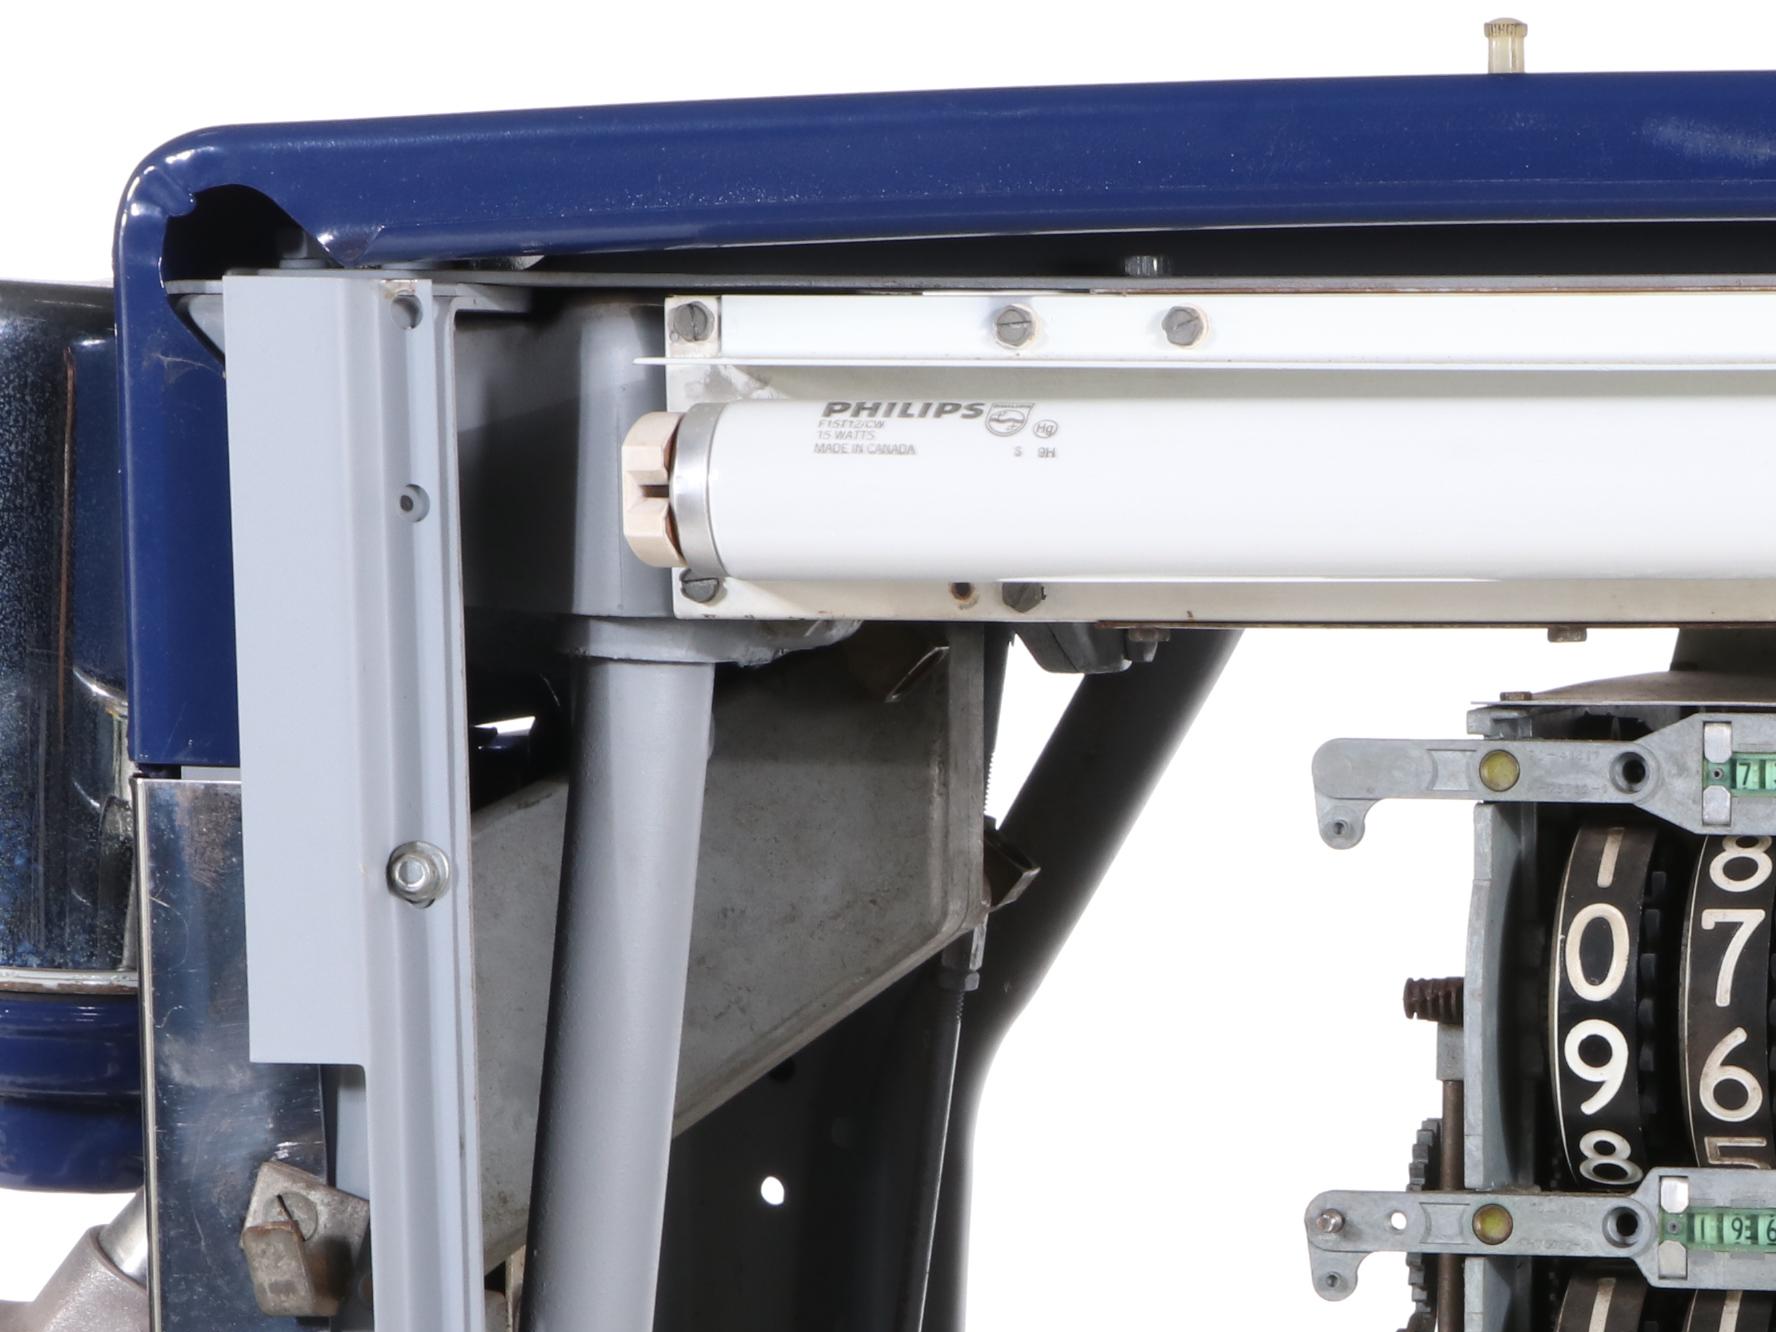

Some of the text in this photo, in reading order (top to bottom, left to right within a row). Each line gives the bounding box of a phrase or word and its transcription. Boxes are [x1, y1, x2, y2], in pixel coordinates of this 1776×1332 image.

[822, 402, 985, 419] PHILIPS
[835, 431, 874, 440] WATTS
[814, 444, 915, 455] MADE IN CANADA
